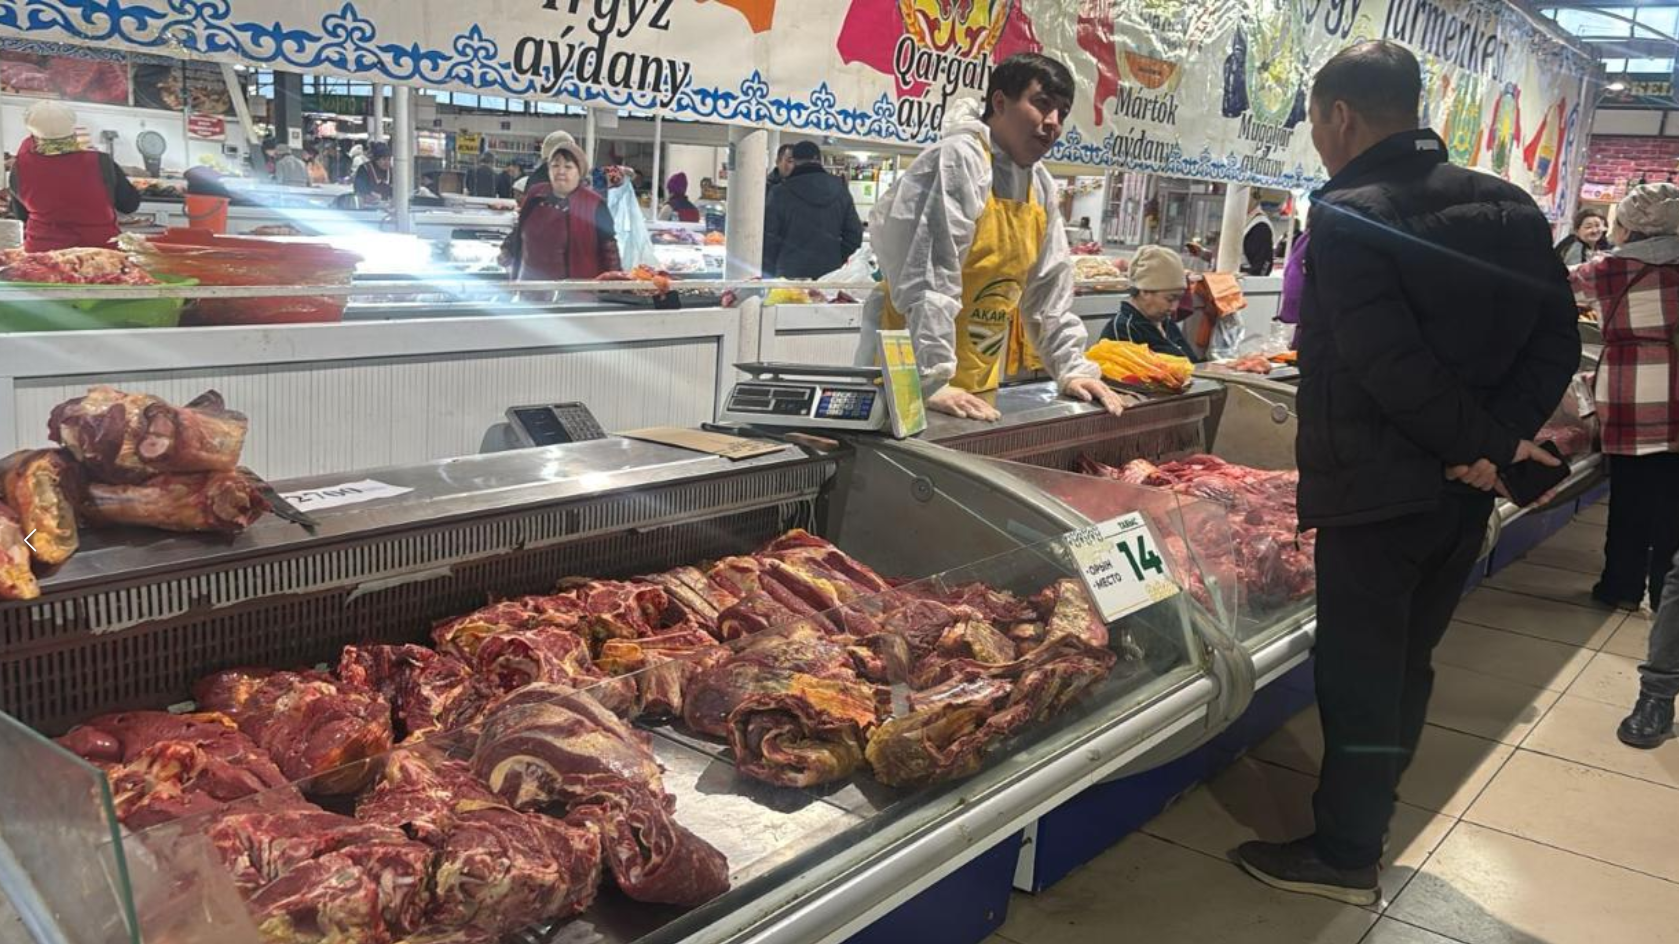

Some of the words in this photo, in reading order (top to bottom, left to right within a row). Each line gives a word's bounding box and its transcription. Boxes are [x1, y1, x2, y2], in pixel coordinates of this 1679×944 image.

[514, 26, 690, 107] aýdany
[897, 90, 946, 139] aýd
[1116, 535, 1163, 581] 14
